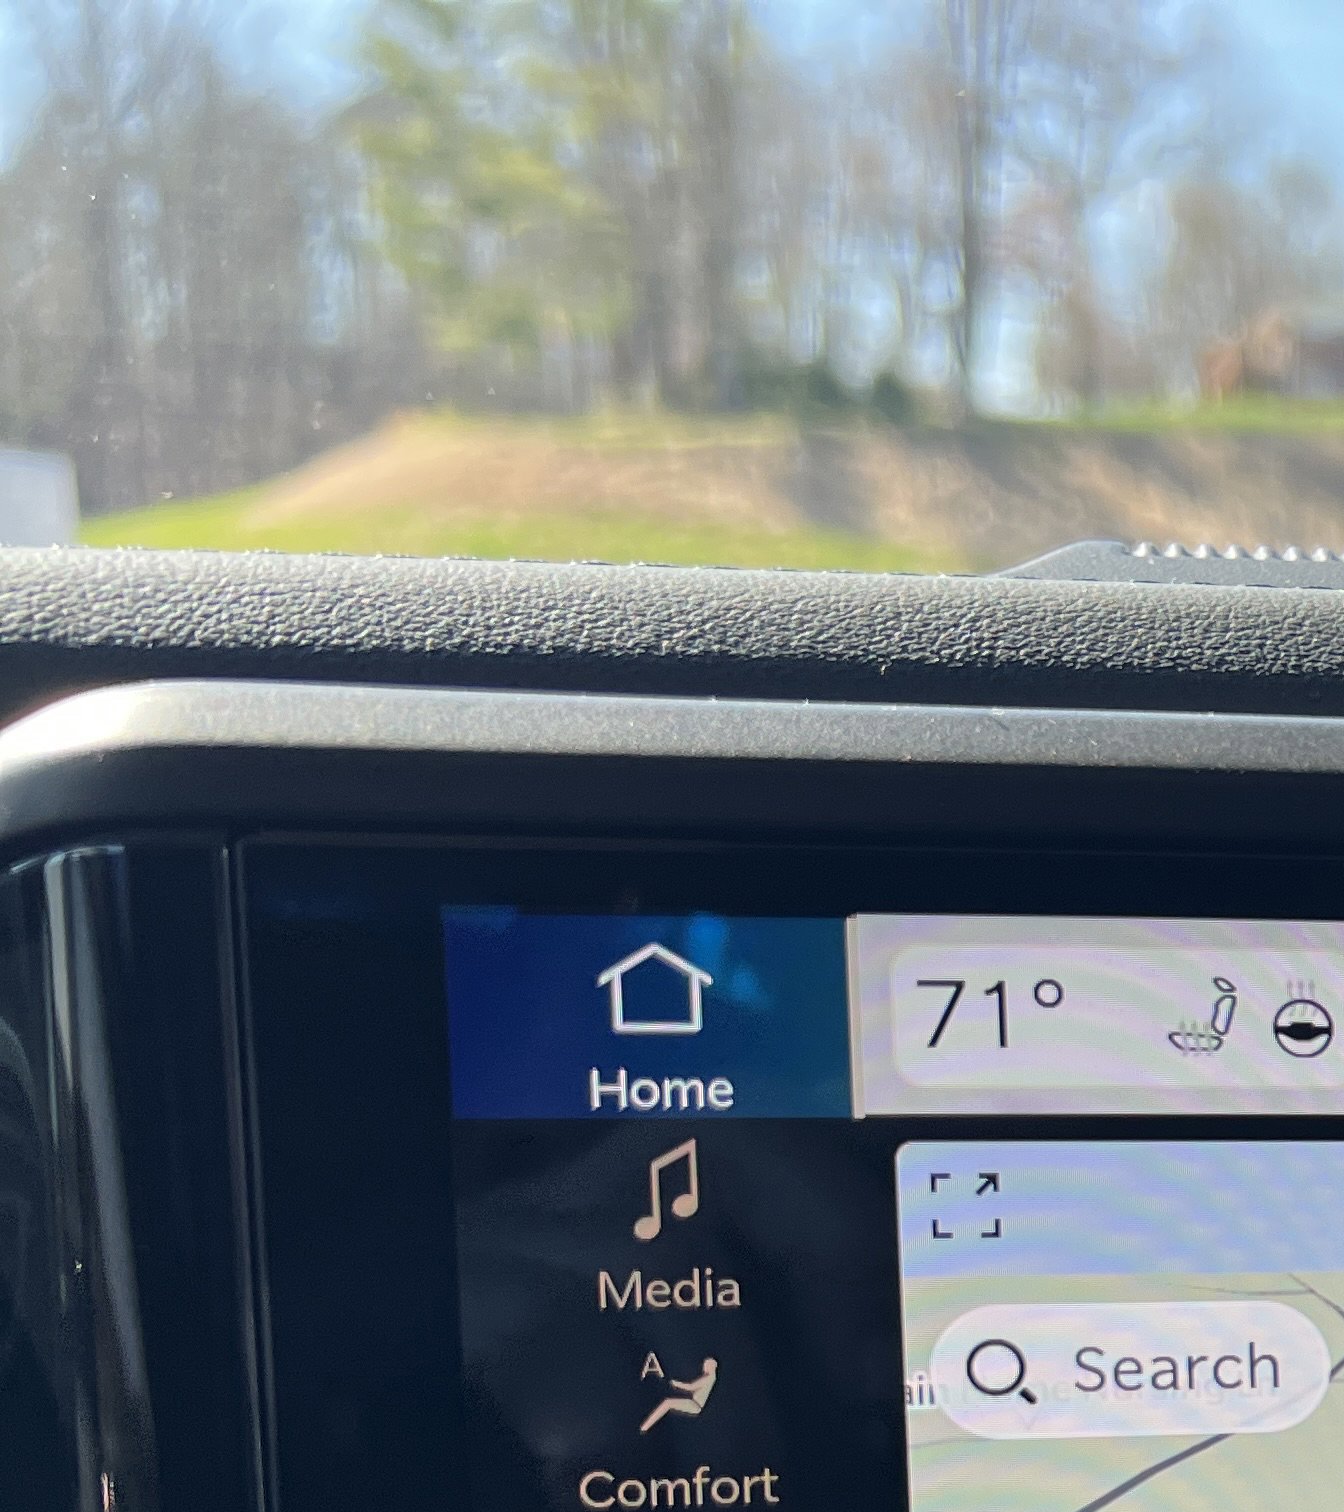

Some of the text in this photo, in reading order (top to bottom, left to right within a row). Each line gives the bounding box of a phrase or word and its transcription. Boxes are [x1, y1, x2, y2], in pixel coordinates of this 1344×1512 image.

[916, 977, 1064, 1050] 71°
[589, 1068, 735, 1112] Home
[599, 1268, 742, 1311] Media
[1075, 1341, 1281, 1393] Search
[579, 1466, 781, 1509] Comfort
